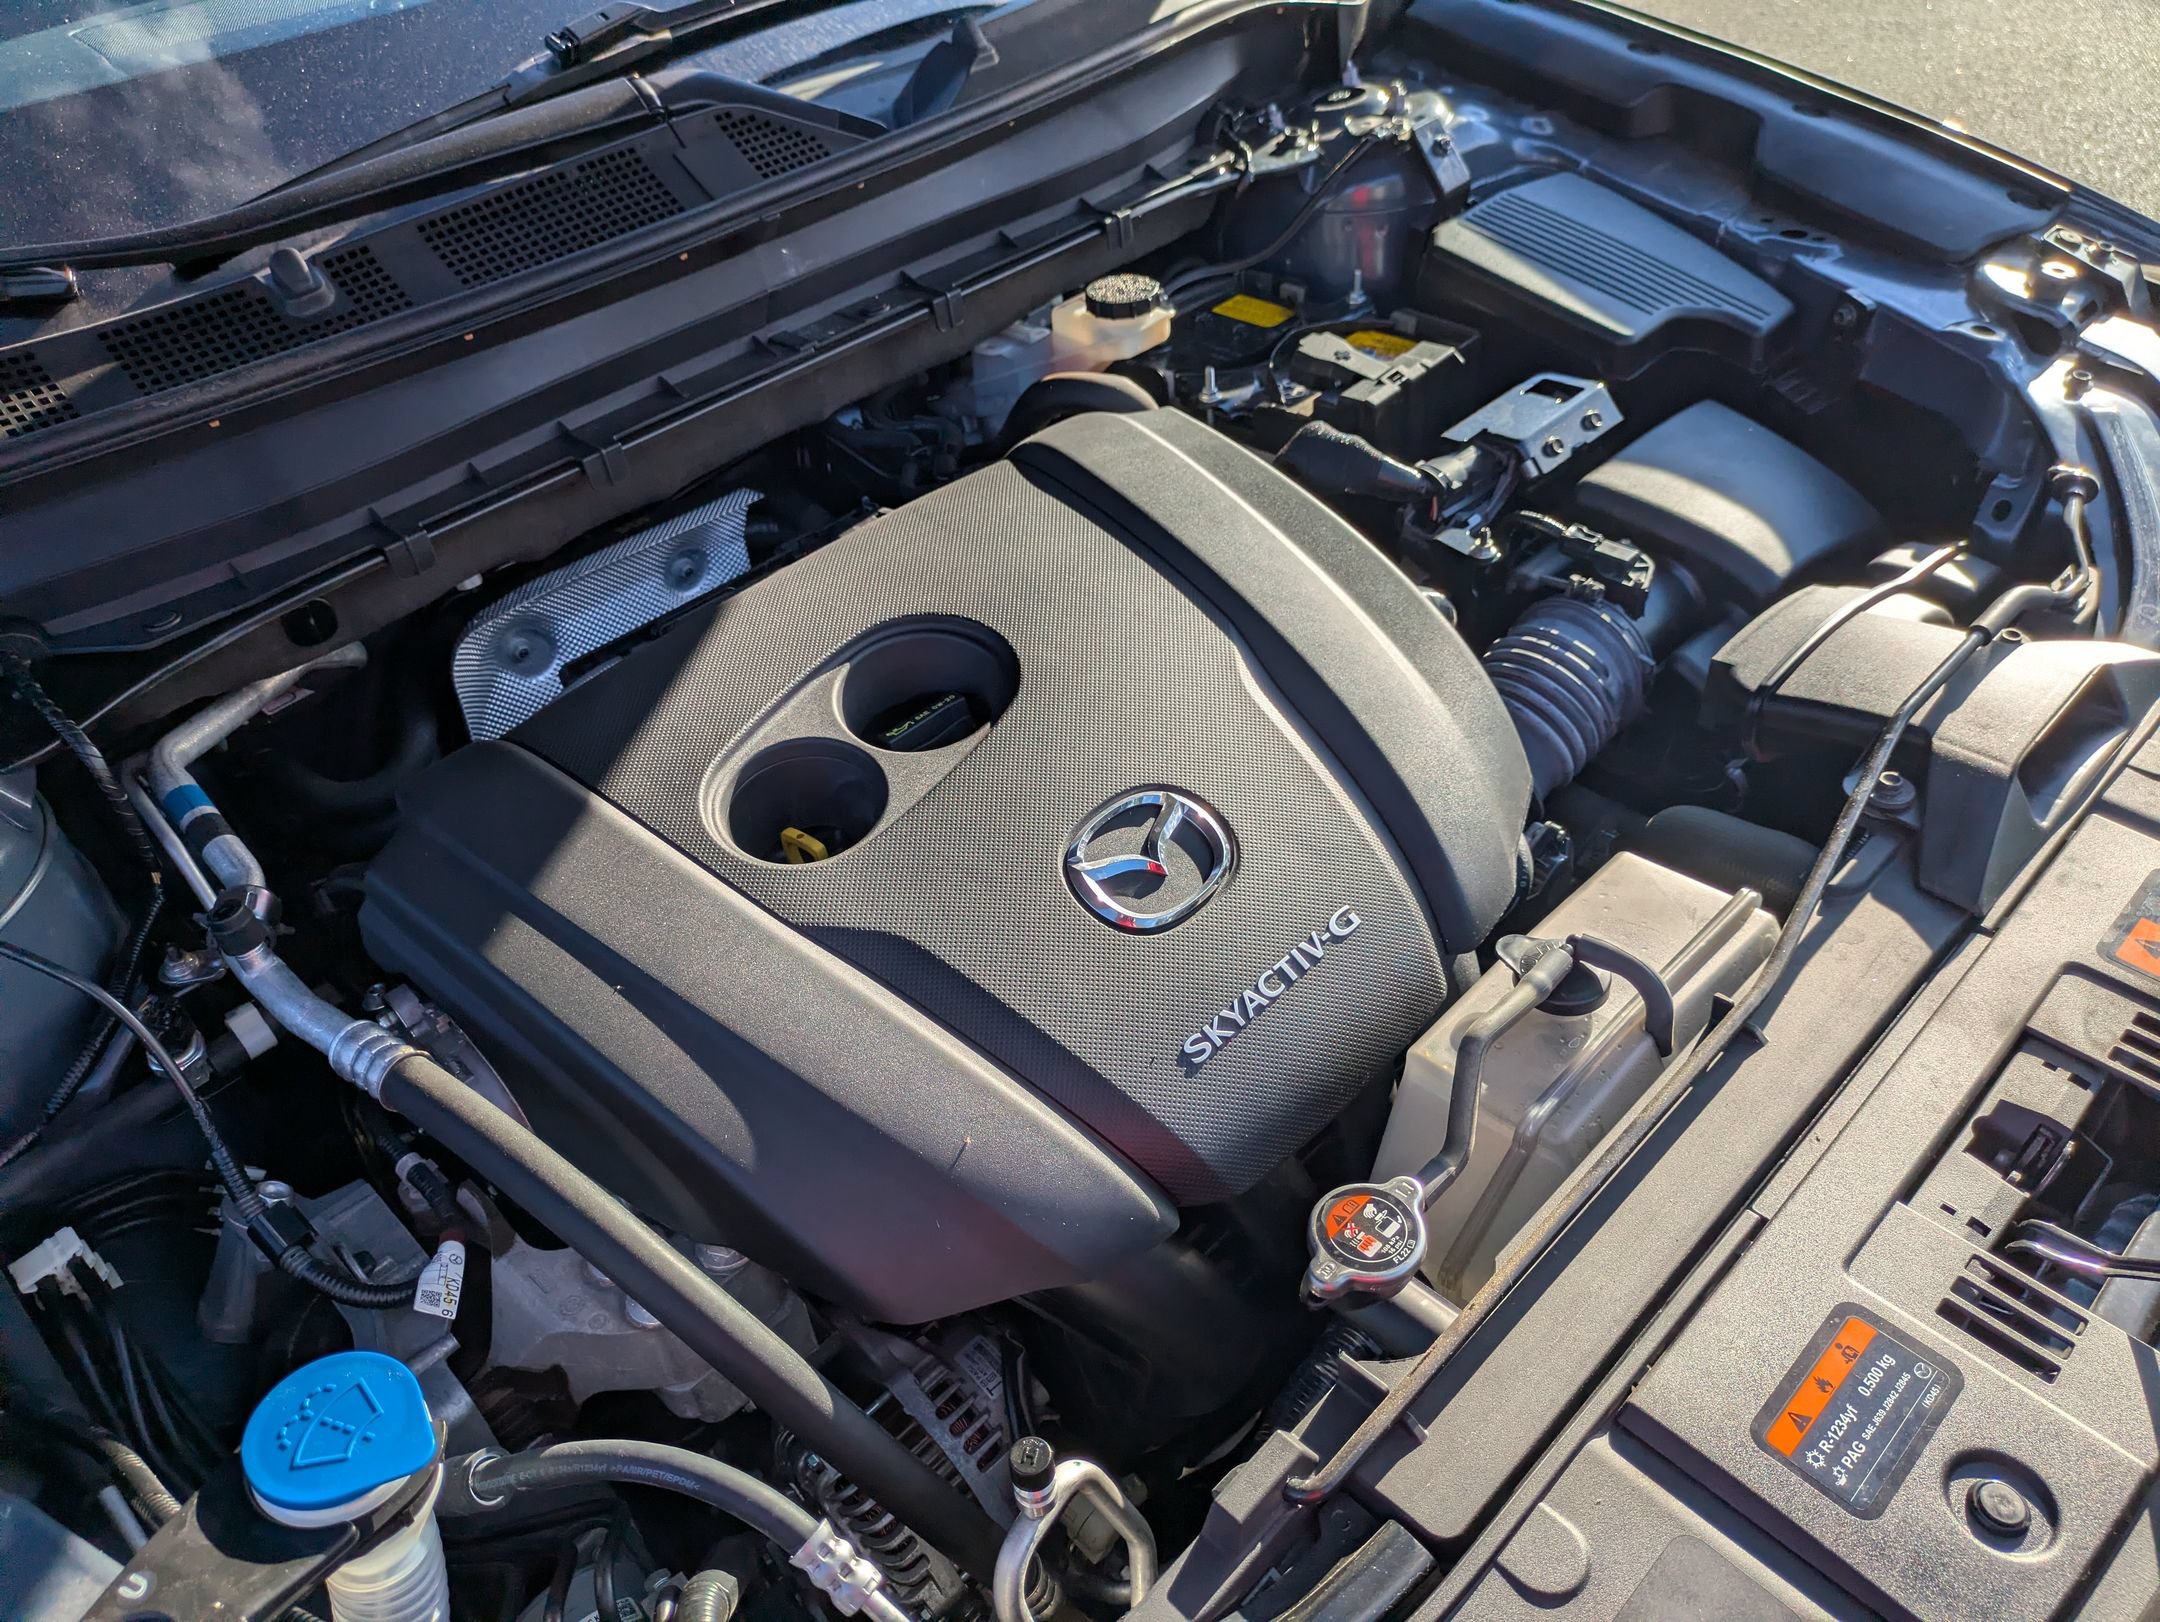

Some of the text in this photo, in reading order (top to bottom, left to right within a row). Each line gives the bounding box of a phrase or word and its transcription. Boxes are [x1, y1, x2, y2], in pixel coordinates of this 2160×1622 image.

[1183, 904, 1362, 1064] SKYACTIV-G
[1388, 1235, 1400, 1246] kPa
[1394, 1239, 1403, 1250] psi
[1392, 1247, 1411, 1264] FL22
[1818, 1353, 1896, 1454] R-1234yf 0.500 kg
[1921, 1384, 1942, 1409] (KD45)
[1841, 1371, 1912, 1470] PAG SAE J639 J2842 J2845
